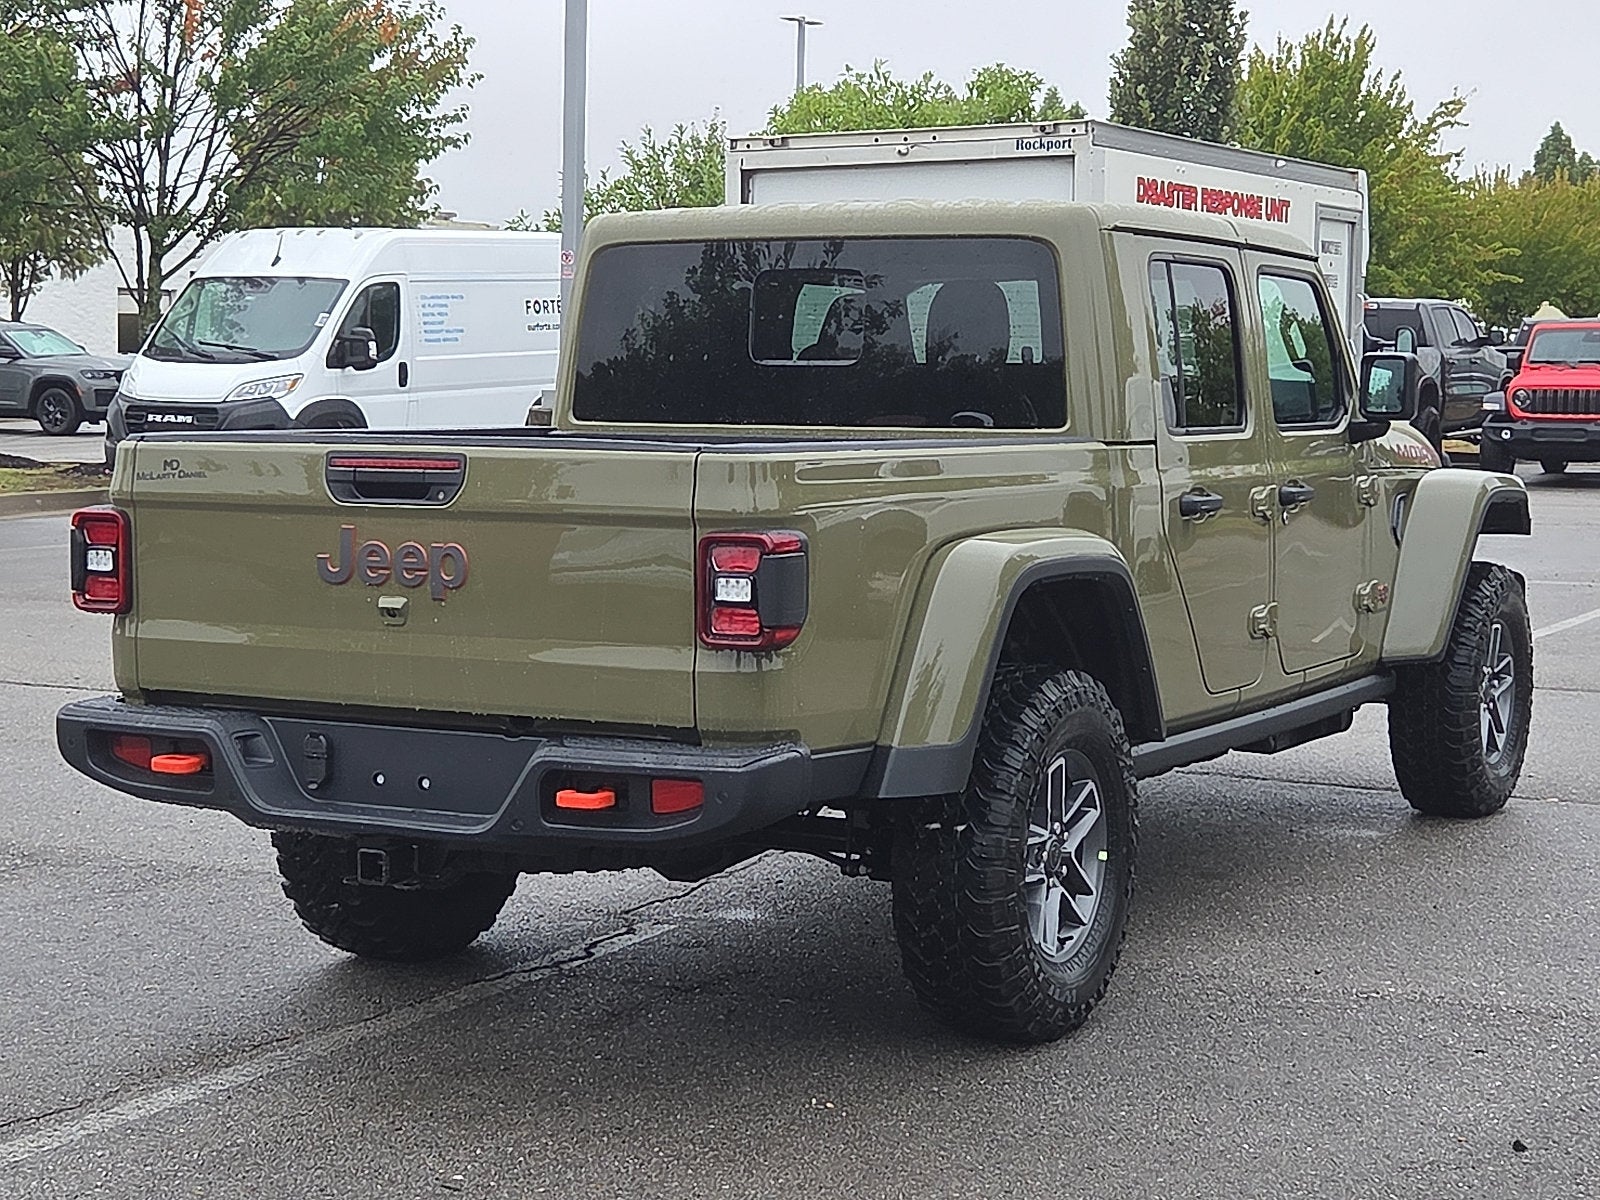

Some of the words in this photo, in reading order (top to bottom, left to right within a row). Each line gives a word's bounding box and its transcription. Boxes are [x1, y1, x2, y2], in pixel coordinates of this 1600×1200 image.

[1015, 137, 1072, 152] Rockport
[1136, 176, 1198, 212] DISASTER
[1201, 187, 1263, 220] RESPONSE
[1265, 197, 1291, 224] UNIT
[147, 413, 193, 424] RAM
[163, 459, 180, 472] MD
[316, 523, 469, 601] Jeep
